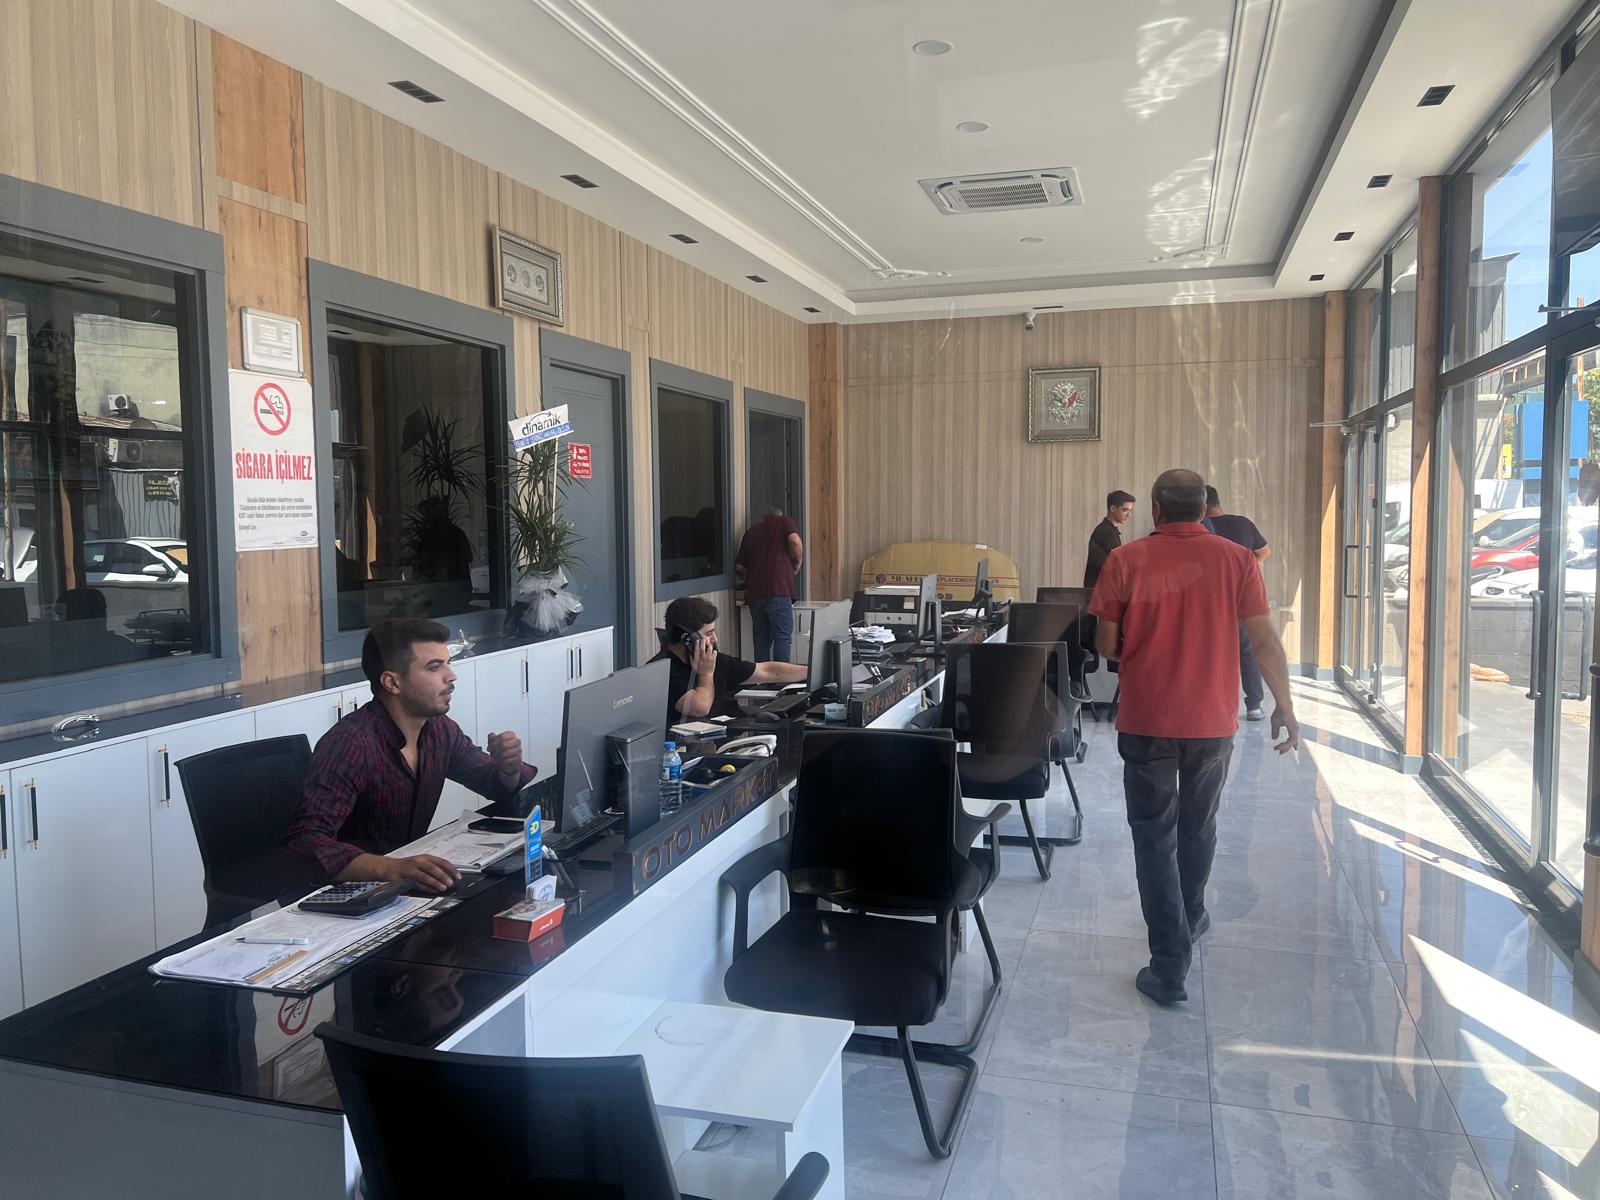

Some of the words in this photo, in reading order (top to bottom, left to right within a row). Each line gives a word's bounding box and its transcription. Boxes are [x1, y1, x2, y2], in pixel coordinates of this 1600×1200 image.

[522, 414, 561, 436] dinamik
[235, 447, 274, 480] SİGARA
[275, 449, 312, 484] İÇİLMEZ
[936, 576, 976, 584] EPLACEMENT
[641, 823, 693, 881] OTO
[697, 760, 776, 842] MARKET
